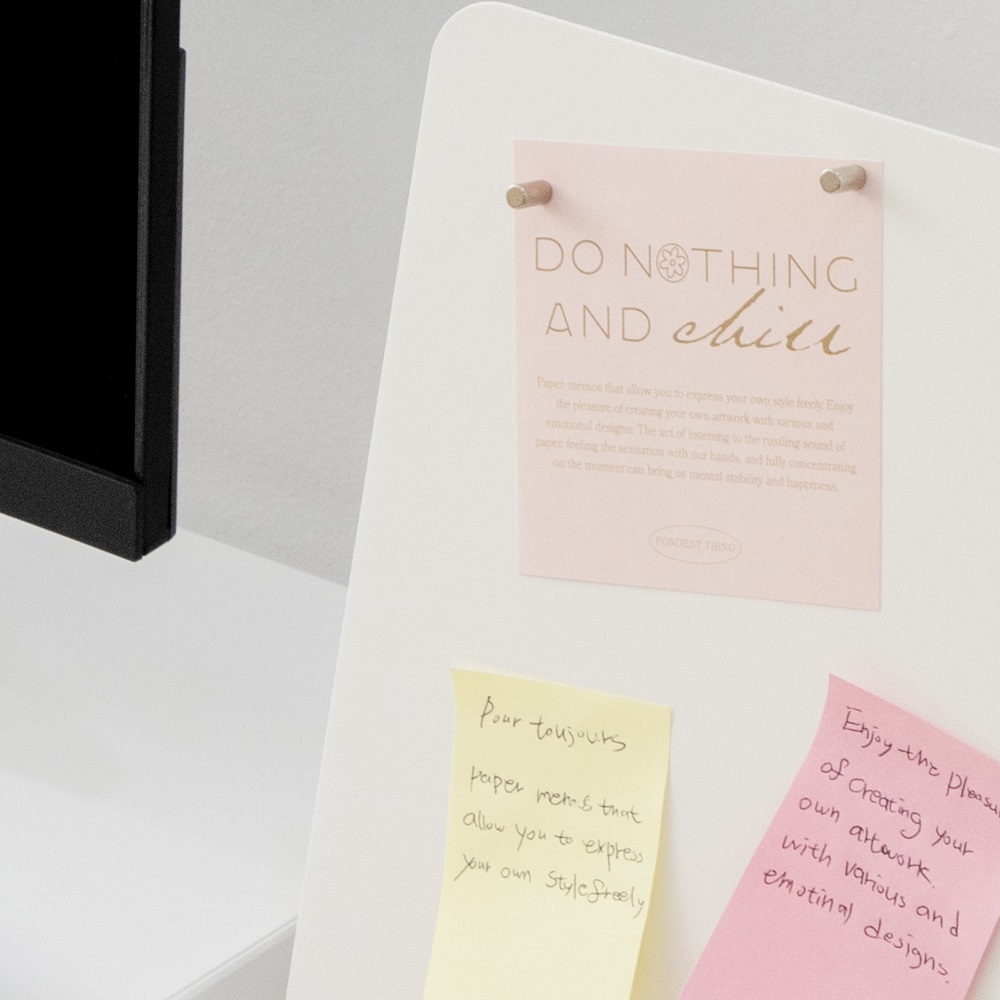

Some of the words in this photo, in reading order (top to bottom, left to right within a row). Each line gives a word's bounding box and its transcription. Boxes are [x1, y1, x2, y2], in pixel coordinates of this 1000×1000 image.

[535, 236, 604, 276] DO
[624, 242, 858, 294] NOTHING
[546, 302, 651, 343] AND
[672, 287, 851, 356] chill
[536, 376, 564, 391] Paper
[567, 381, 601, 393] memos
[605, 382, 623, 394] that
[626, 384, 651, 396] allow
[654, 387, 671, 400] you
[674, 389, 684, 399] to
[686, 390, 723, 403] express
[725, 392, 747, 405] your
[750, 395, 771, 406] own
[772, 396, 794, 410] style
[797, 397, 823, 411] freely.
[826, 399, 855, 414] Enjoy
[556, 398, 571, 410] the
[573, 400, 612, 413] pleasure
[614, 403, 625, 414] of
[625, 404, 663, 419] creating
[665, 408, 686, 420] your
[688, 412, 710, 422] own
[713, 412, 751, 425] artwork
[752, 415, 775, 427] with
[776, 417, 813, 430] various
[815, 419, 834, 431] and
[545, 419, 593, 431] emotional
[595, 421, 634, 436] designs.
[637, 423, 657, 436] The
[659, 427, 674, 438] act
[676, 428, 687, 439] of
[688, 429, 730, 444] listening
[732, 433, 743, 443] to
[744, 433, 760, 445] the
[763, 436, 800, 451] rustling
[803, 439, 833, 452] sound
[835, 440, 847, 453] of
[536, 438, 564, 450] paper,
[566, 437, 598, 453] feeling
[601, 441, 616, 453] the
[619, 444, 665, 457] sensation
[667, 447, 689, 460] with
[690, 451, 708, 461] our
[710, 450, 741, 464] hands,
[744, 454, 763, 466] and
[765, 456, 786, 470] fully
[788, 459, 858, 475] concentrating
[552, 459, 565, 469] on
[567, 458, 582, 470] the
[585, 461, 625, 474] moment
[627, 464, 645, 475] can
[647, 466, 673, 480] bring
[675, 469, 686, 479] us
[689, 470, 723, 482] mental
[726, 473, 763, 487] stability
[765, 476, 784, 488] and
[787, 477, 839, 492] happiness.
[479, 695, 523, 728] Pour
[529, 715, 627, 752] toujours
[842, 706, 893, 757] Enjoy
[897, 745, 941, 778] the
[820, 757, 850, 781] of
[598, 798, 643, 824] that
[798, 796, 842, 823] own
[462, 810, 505, 833] allow
[553, 829, 574, 846] to
[581, 838, 645, 873] express
[499, 866, 533, 883] own
[781, 834, 833, 868] with
[915, 910, 961, 938] and
